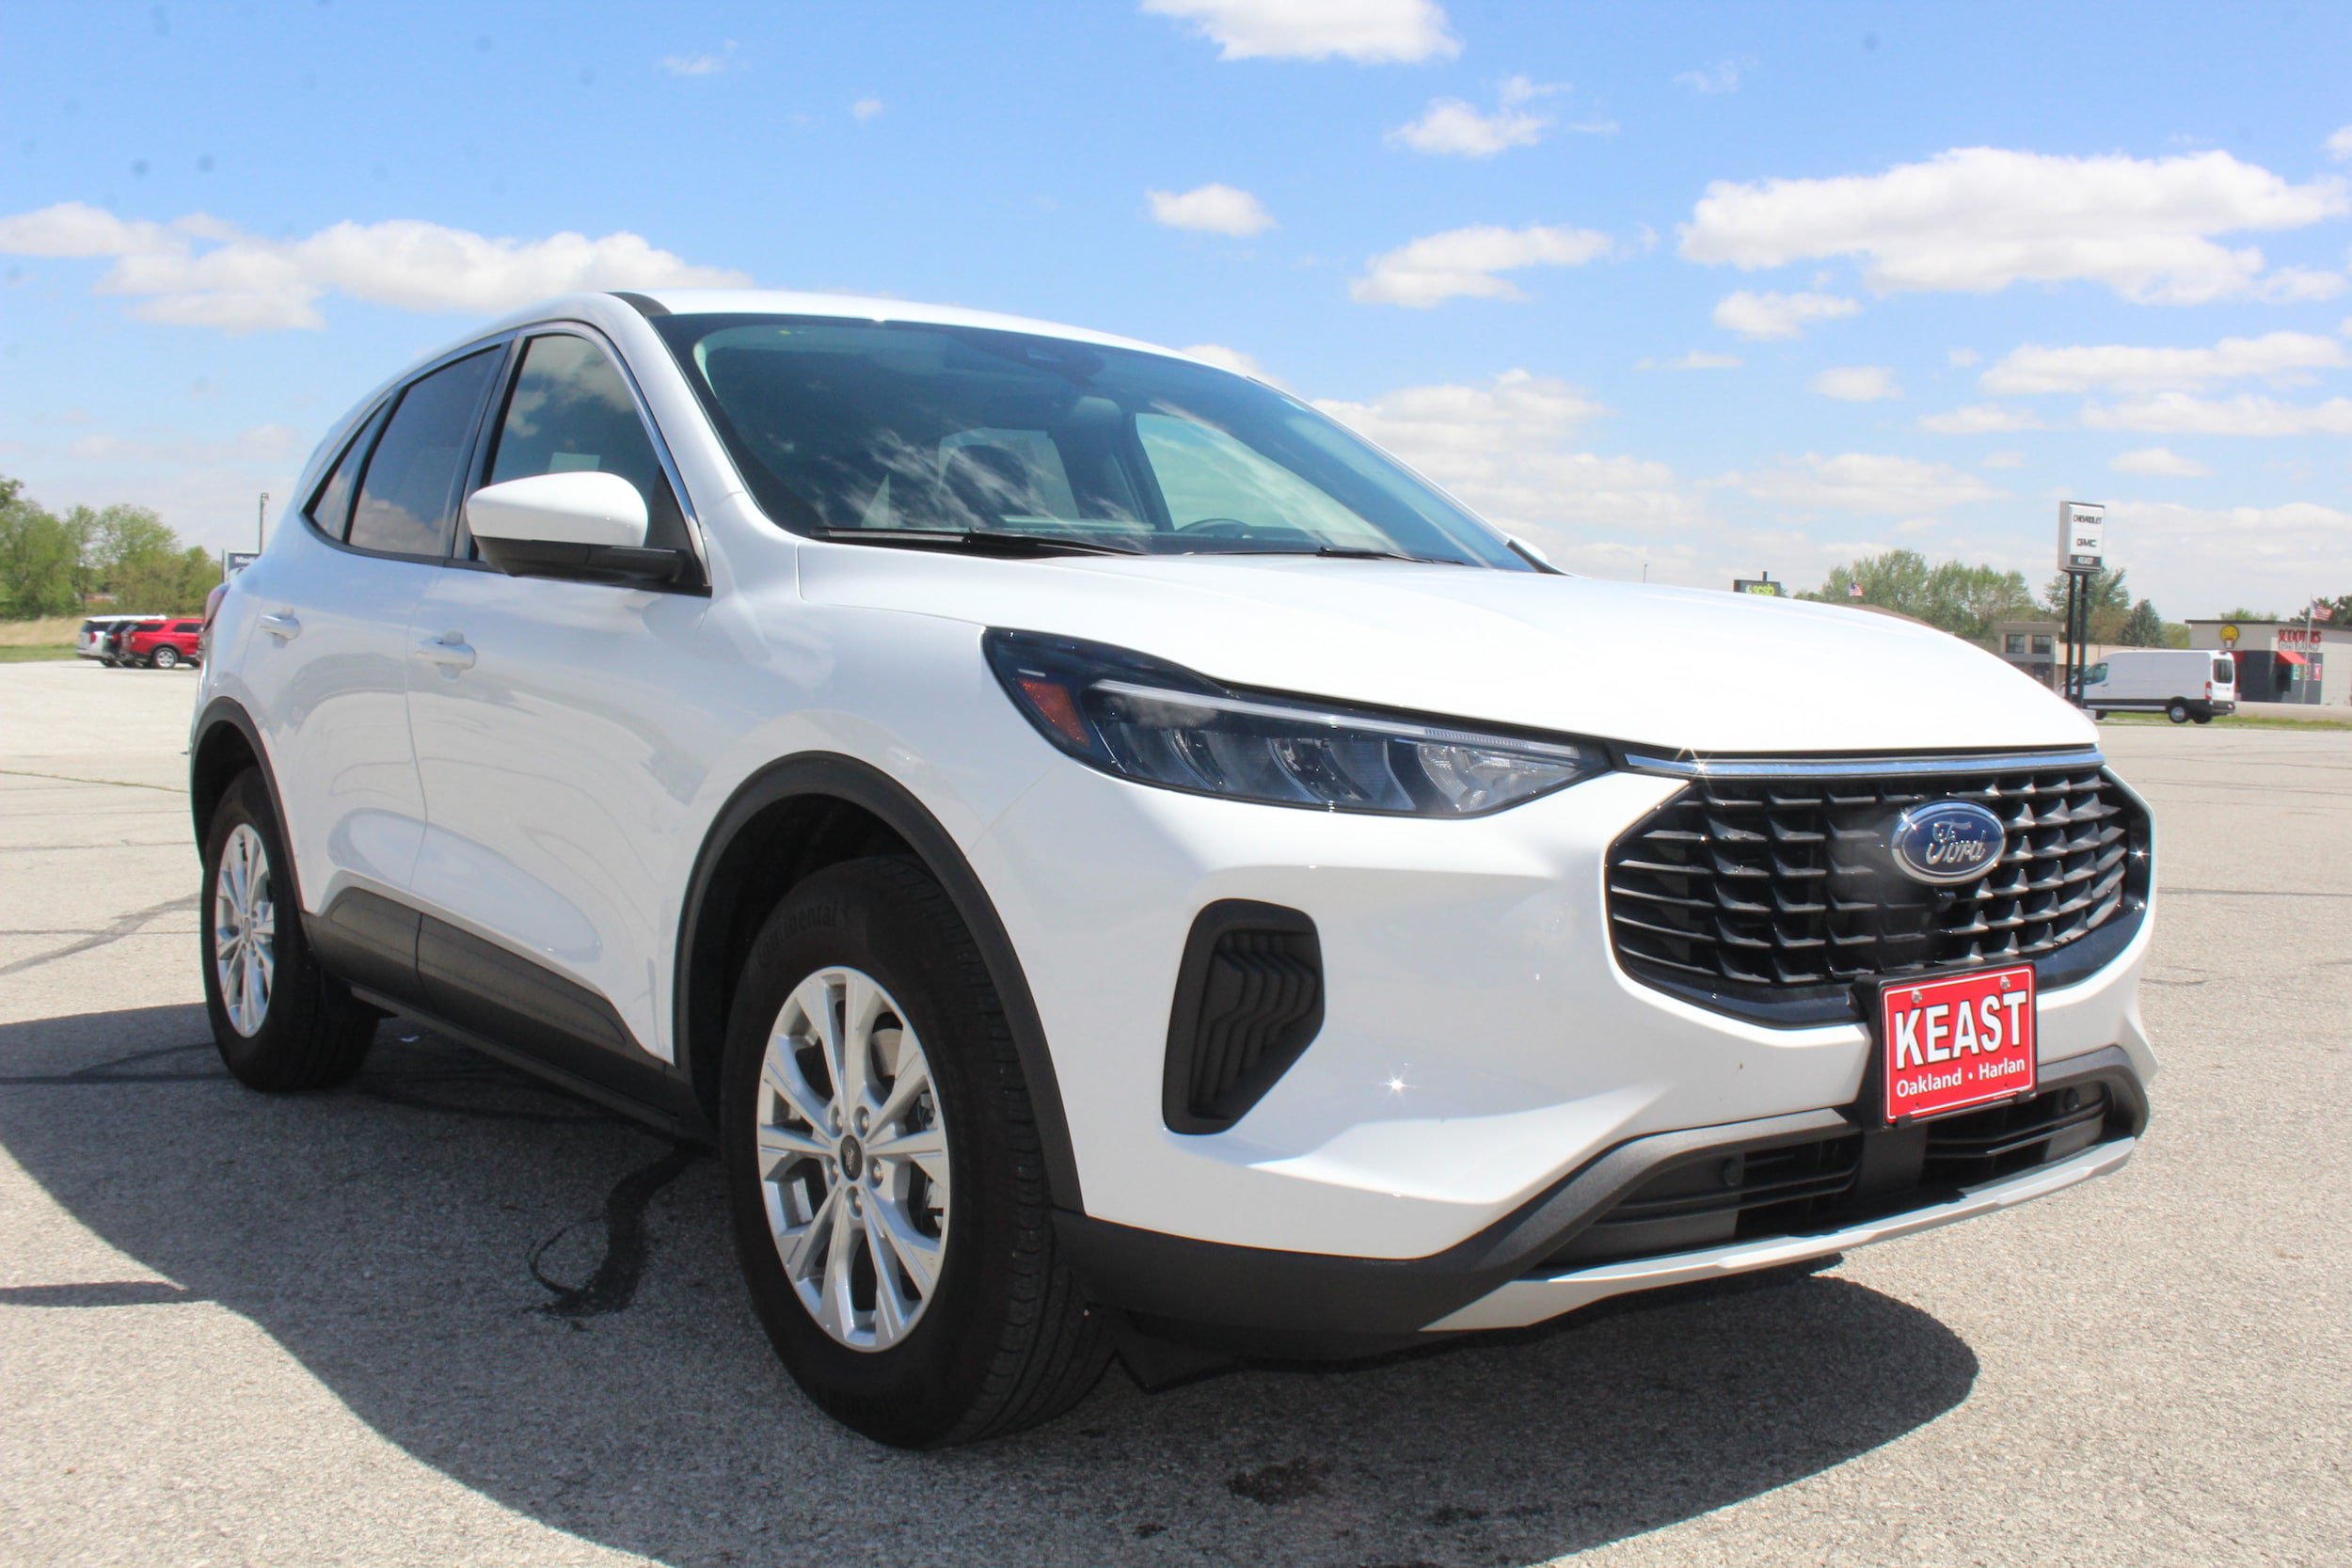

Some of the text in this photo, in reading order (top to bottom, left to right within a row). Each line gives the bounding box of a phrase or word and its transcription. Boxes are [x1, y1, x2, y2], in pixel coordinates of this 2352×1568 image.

[2074, 515, 2102, 524] CHEVROLET
[2076, 538, 2097, 547] GMC
[1926, 819, 1986, 865] Ford
[1894, 990, 2027, 1069] KEAST
[1896, 1056, 2026, 1099] Oakland Harlan
